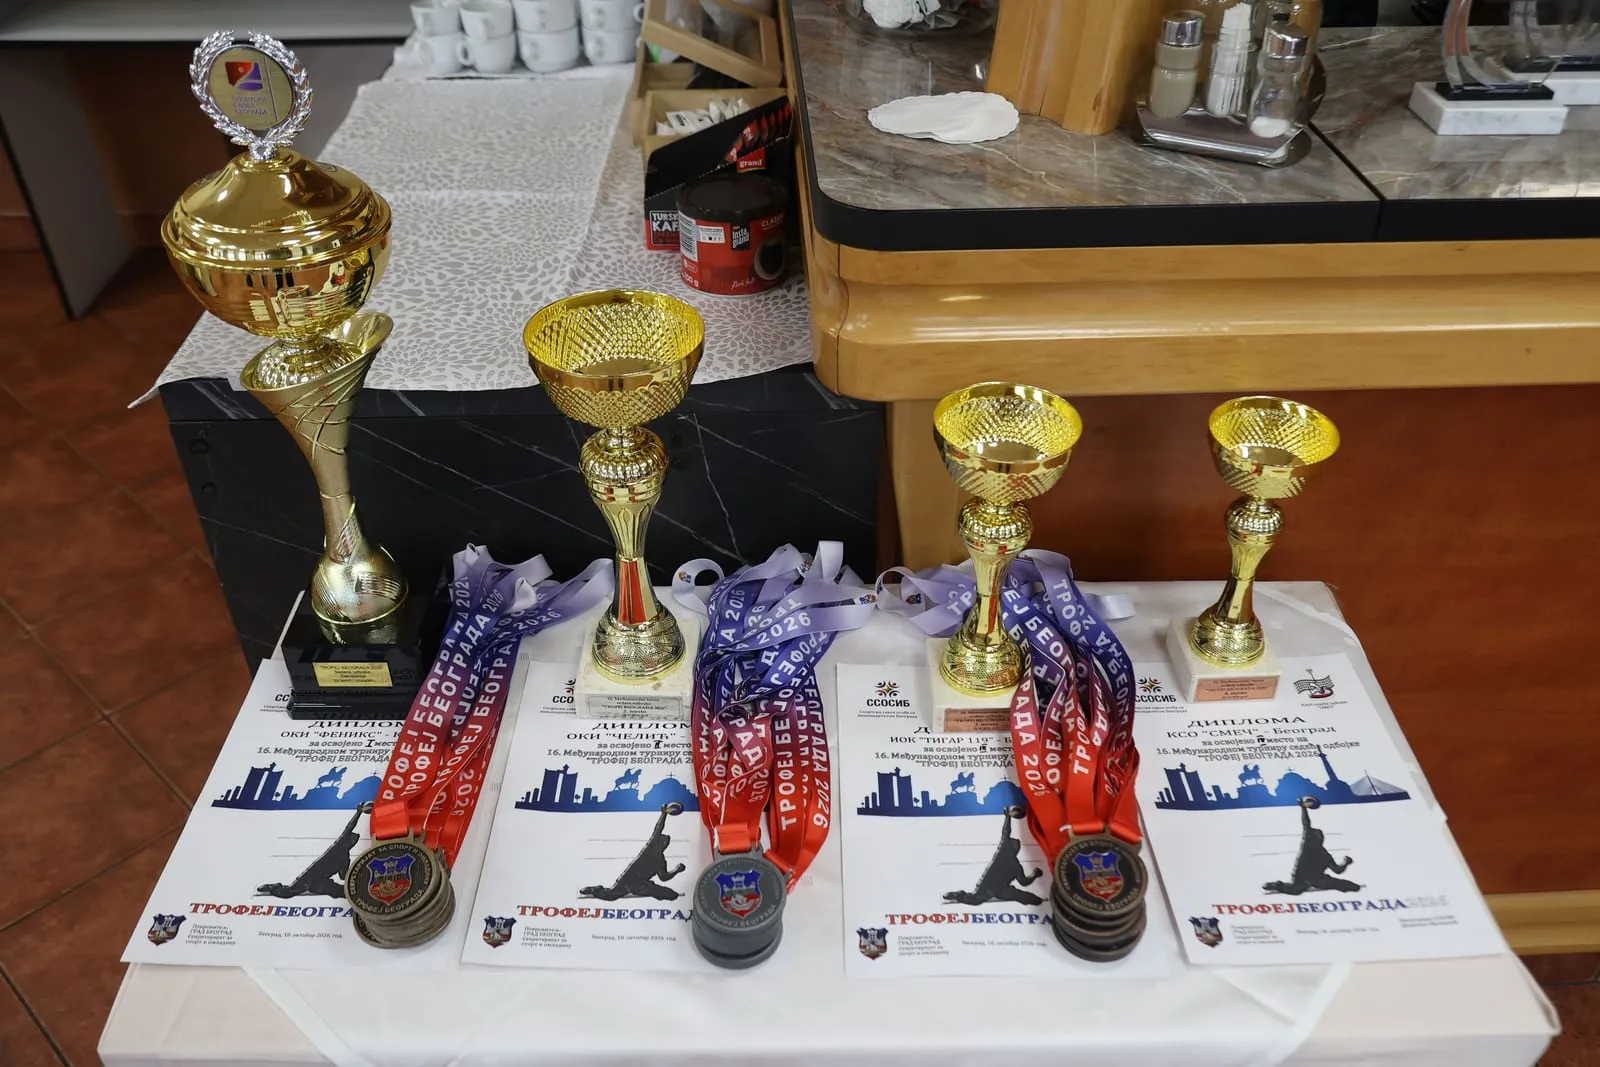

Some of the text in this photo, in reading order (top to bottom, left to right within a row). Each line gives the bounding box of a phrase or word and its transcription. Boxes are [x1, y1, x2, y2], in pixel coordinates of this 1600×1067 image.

[739, 158, 763, 168] grand
[725, 589, 745, 621] 2026
[513, 608, 561, 630] 2026
[757, 612, 811, 645] 2026
[427, 614, 491, 728] БЕОГРАДА
[482, 589, 505, 613] 2026
[866, 698, 910, 707] ССОСИБ
[1188, 716, 1307, 728] ДИПЛОМА
[314, 730, 382, 739] "ФЕНИКС"
[1273, 726, 1337, 735] Београд
[320, 740, 363, 749] освојено
[610, 742, 652, 750] освојено
[1214, 738, 1255, 747] освојено
[273, 747, 346, 756] Међународном
[348, 748, 390, 756] турниру
[936, 746, 978, 754] освојено
[1156, 747, 1171, 755] 16.
[1173, 746, 1246, 756] Међународном
[1247, 744, 1287, 754] турниру
[1322, 740, 1361, 750] одбојке
[563, 749, 638, 758] Међународном
[891, 752, 965, 761] Међународном
[1243, 751, 1294, 760] БЕОГРАДА
[338, 755, 390, 763] БЕОГРАДА
[630, 757, 683, 765] БЕОГРАДА
[960, 760, 1014, 768] БЕОГРАДА
[776, 751, 797, 831] ТРОФЕЈ
[813, 777, 830, 829] 2026
